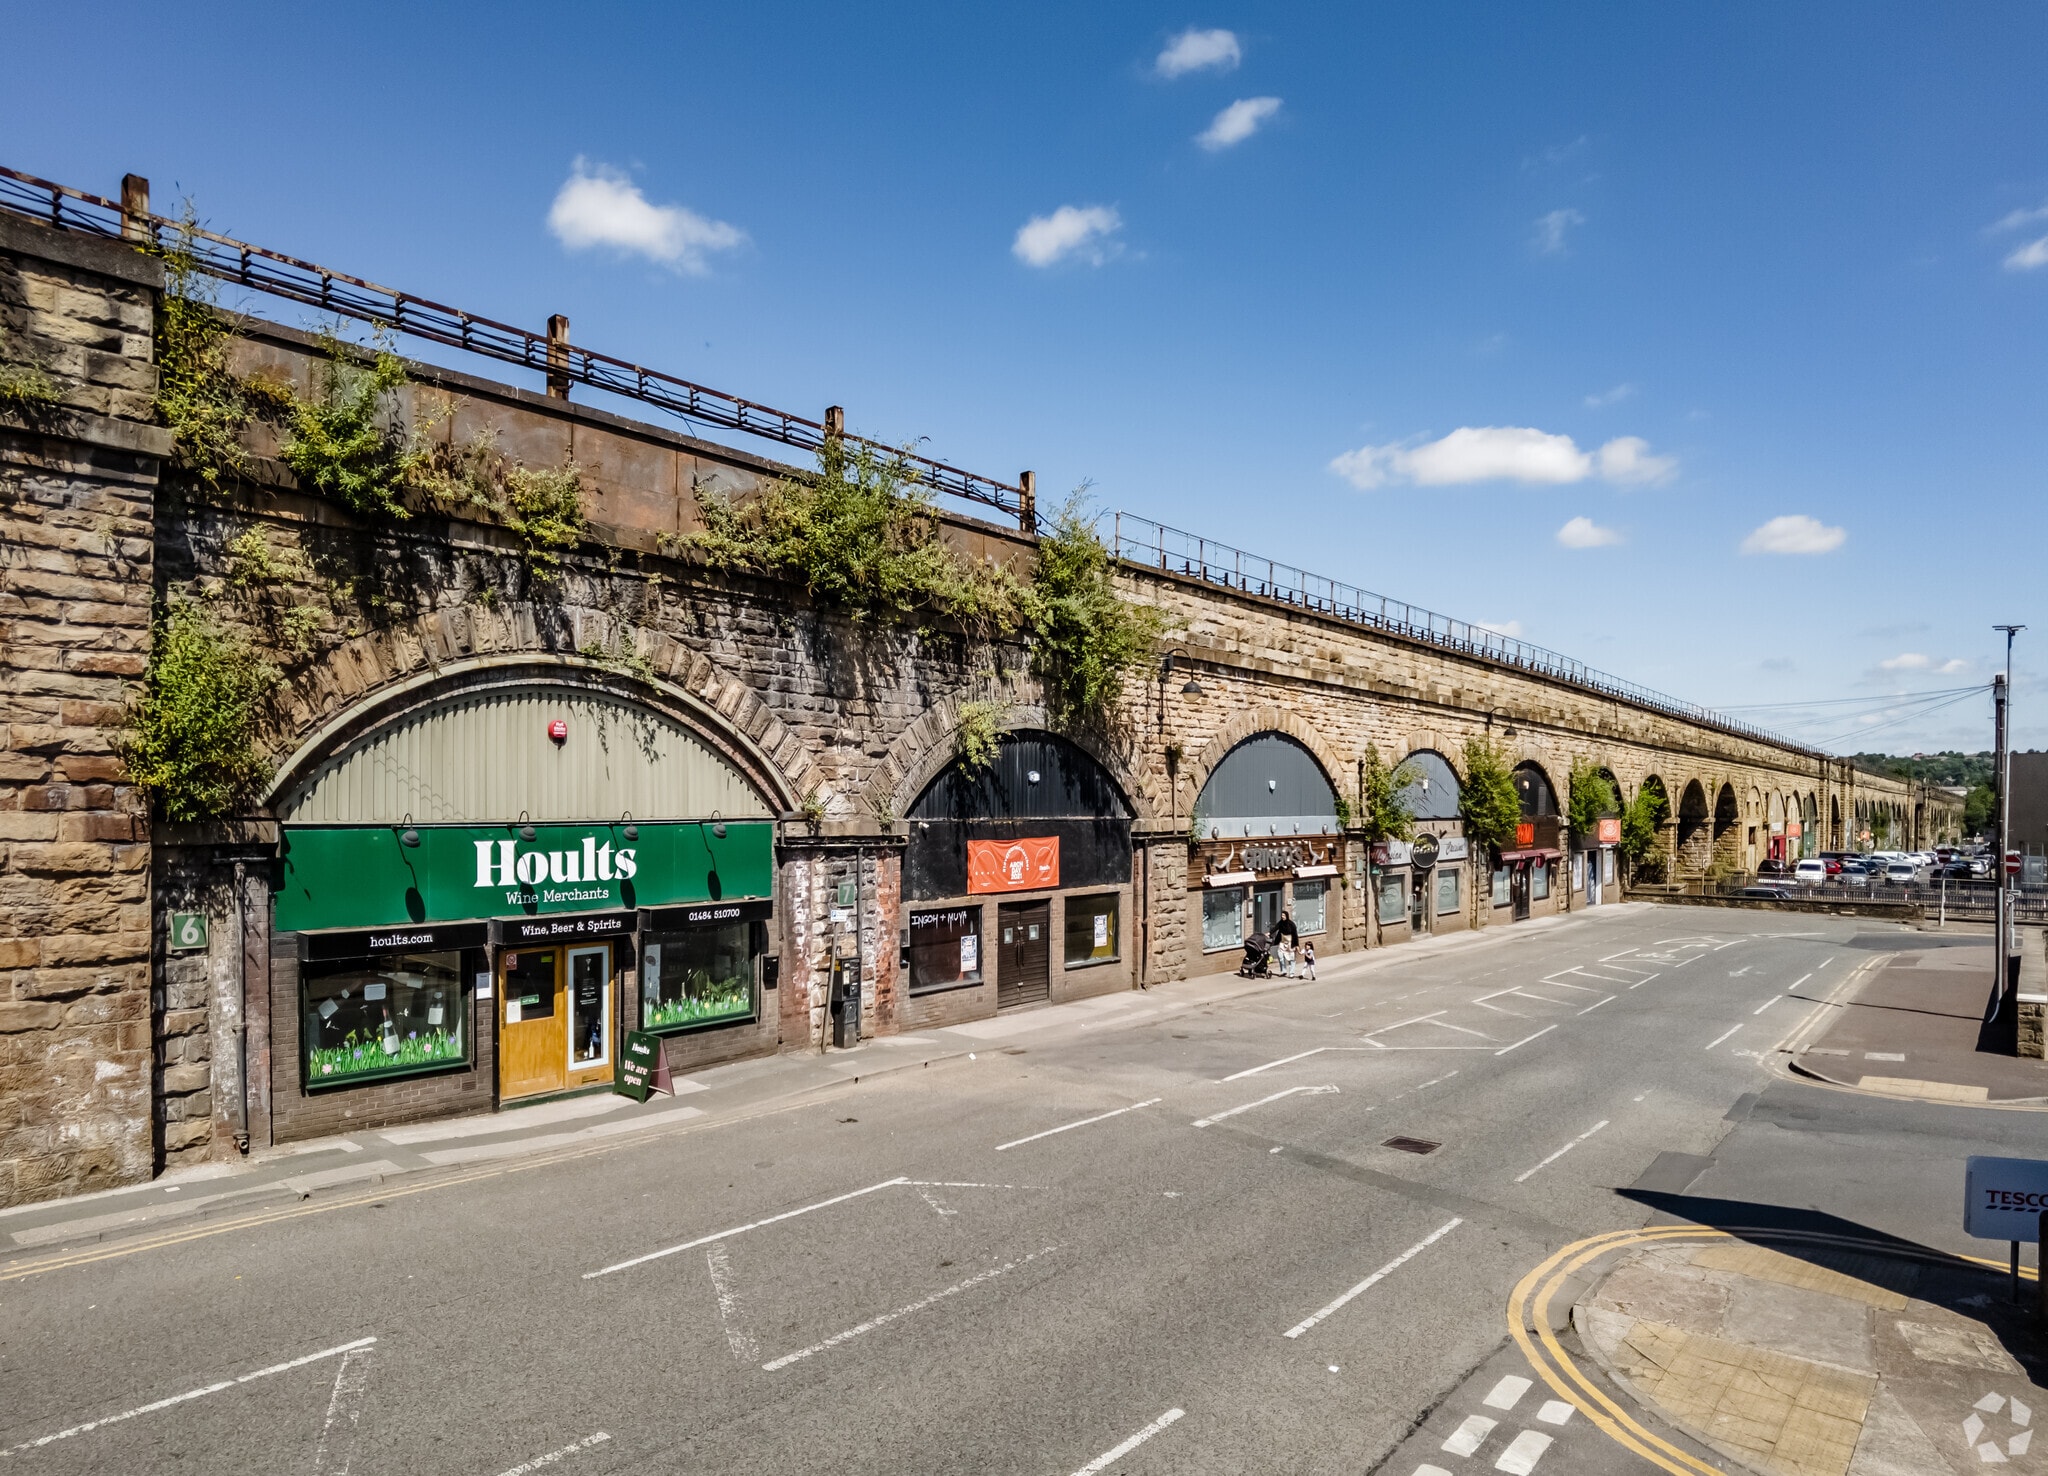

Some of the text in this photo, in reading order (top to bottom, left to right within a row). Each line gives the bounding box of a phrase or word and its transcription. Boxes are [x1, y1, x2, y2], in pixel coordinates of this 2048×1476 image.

[473, 836, 638, 888] Hoults
[506, 887, 609, 905] Wine Merchants
[843, 885, 851, 903] 7
[688, 908, 740, 921] 01484 510700
[181, 917, 199, 945] 6
[521, 919, 622, 936] Wine, Beer & Spirits
[370, 933, 433, 947] hoults.com
[632, 1042, 650, 1055] Hoults
[624, 1060, 648, 1075] We are
[624, 1074, 642, 1086] open
